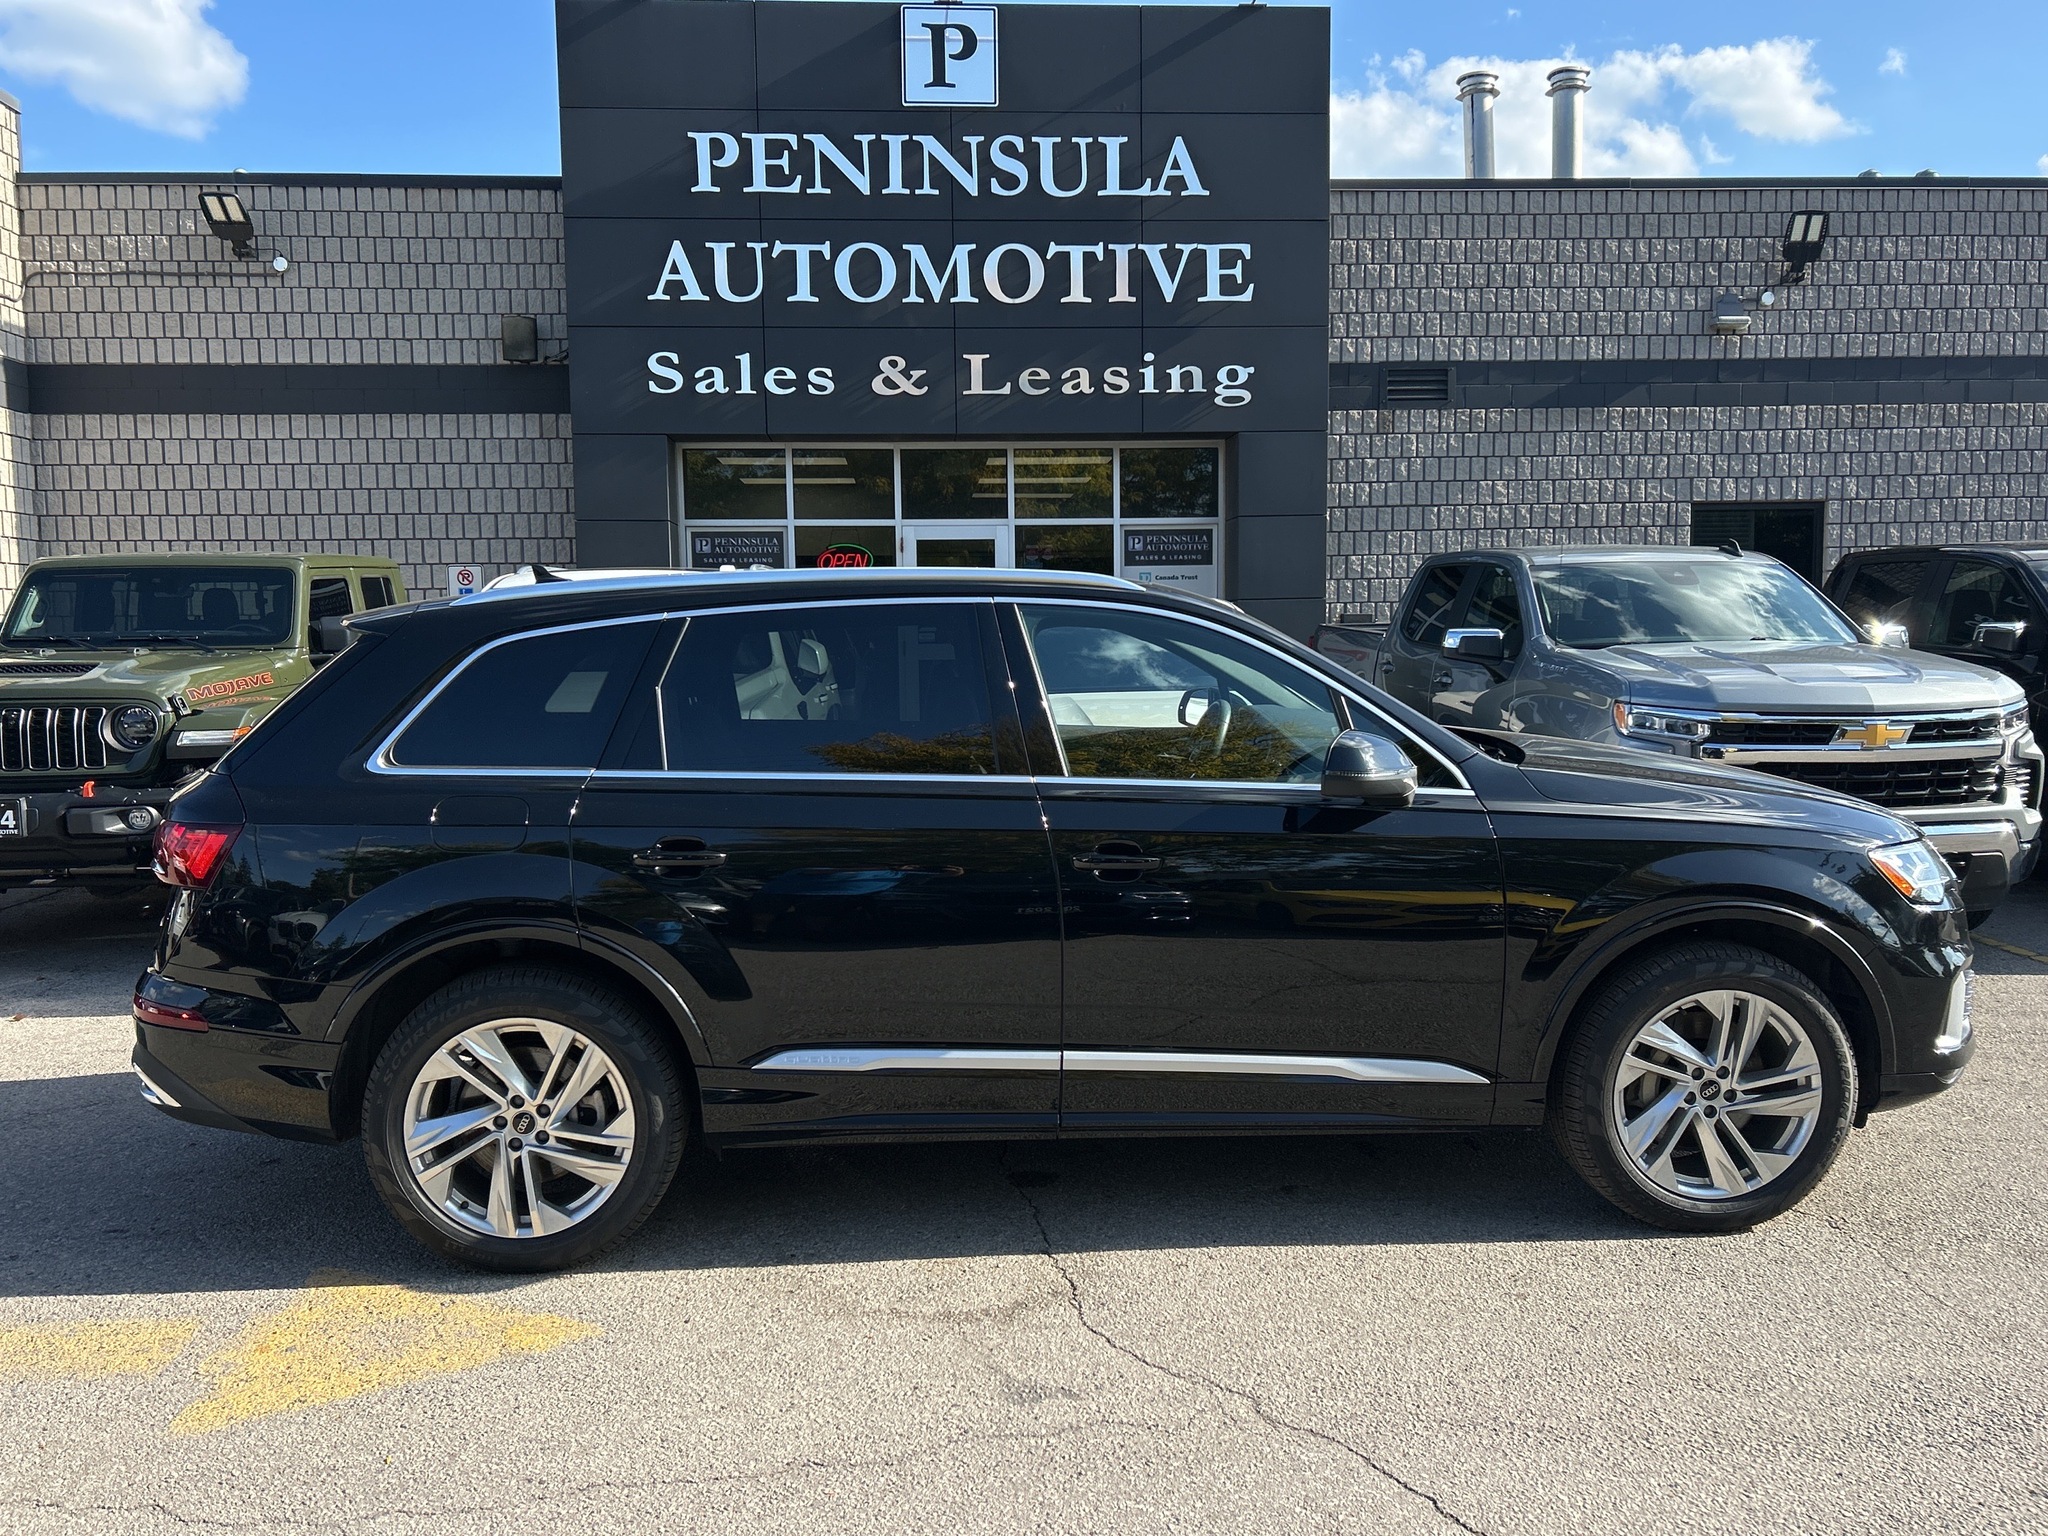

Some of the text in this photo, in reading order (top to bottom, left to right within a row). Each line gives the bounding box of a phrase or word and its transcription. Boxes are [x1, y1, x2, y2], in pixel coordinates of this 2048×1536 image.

[921, 22, 979, 89] P
[687, 131, 1210, 198] PENINSULA
[647, 239, 1255, 304] AUTOMOTIVE
[647, 351, 1255, 407] Sales & Leasing
[714, 537, 779, 546] PENINSULA
[714, 546, 780, 554] AUTOMOTIVE
[1146, 535, 1208, 543] PENINSULA
[1146, 543, 1209, 551] AUTOMOTIVE
[820, 553, 868, 568] OPEN
[186, 671, 274, 701] MOJAVE
